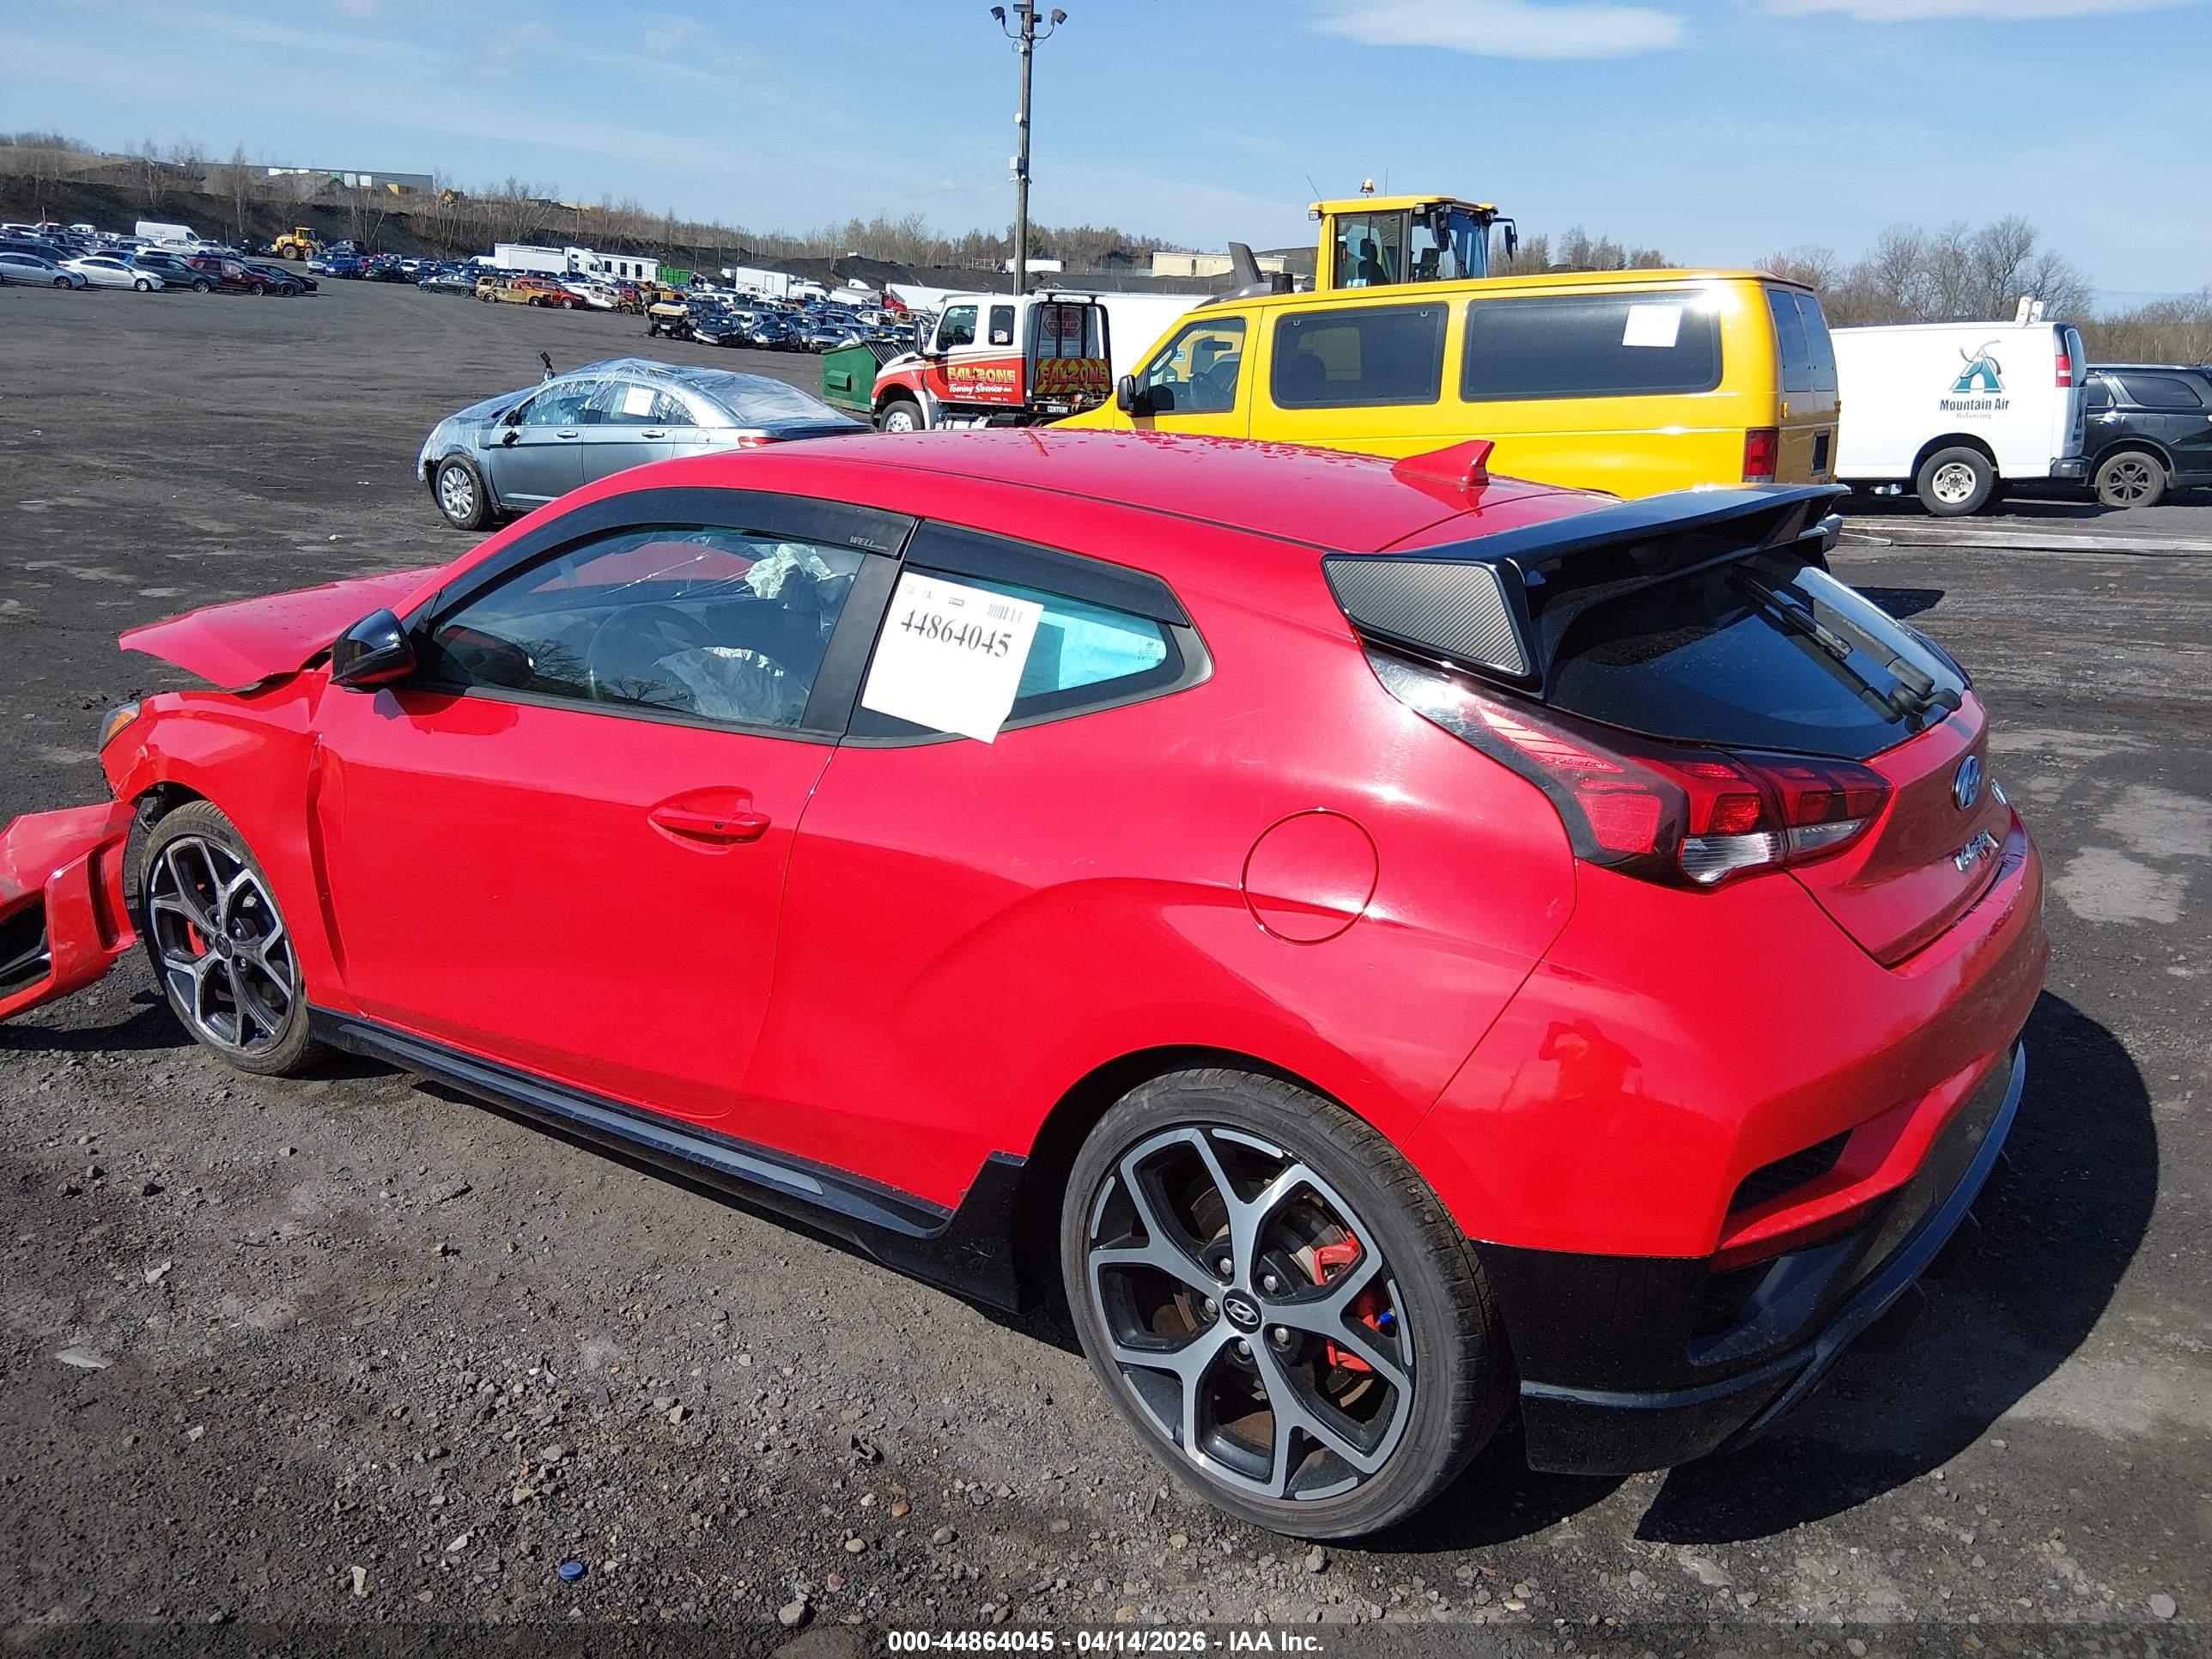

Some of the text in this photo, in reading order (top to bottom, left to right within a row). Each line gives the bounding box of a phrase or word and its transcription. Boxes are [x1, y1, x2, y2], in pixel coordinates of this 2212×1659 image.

[947, 367, 1016, 384] FALZONE
[1038, 367, 1109, 385] FALZONE
[948, 383, 975, 395] Towing
[975, 382, 1003, 392] Service
[1940, 398, 2010, 411] Mountain Air
[900, 609, 1012, 658] 44864045
